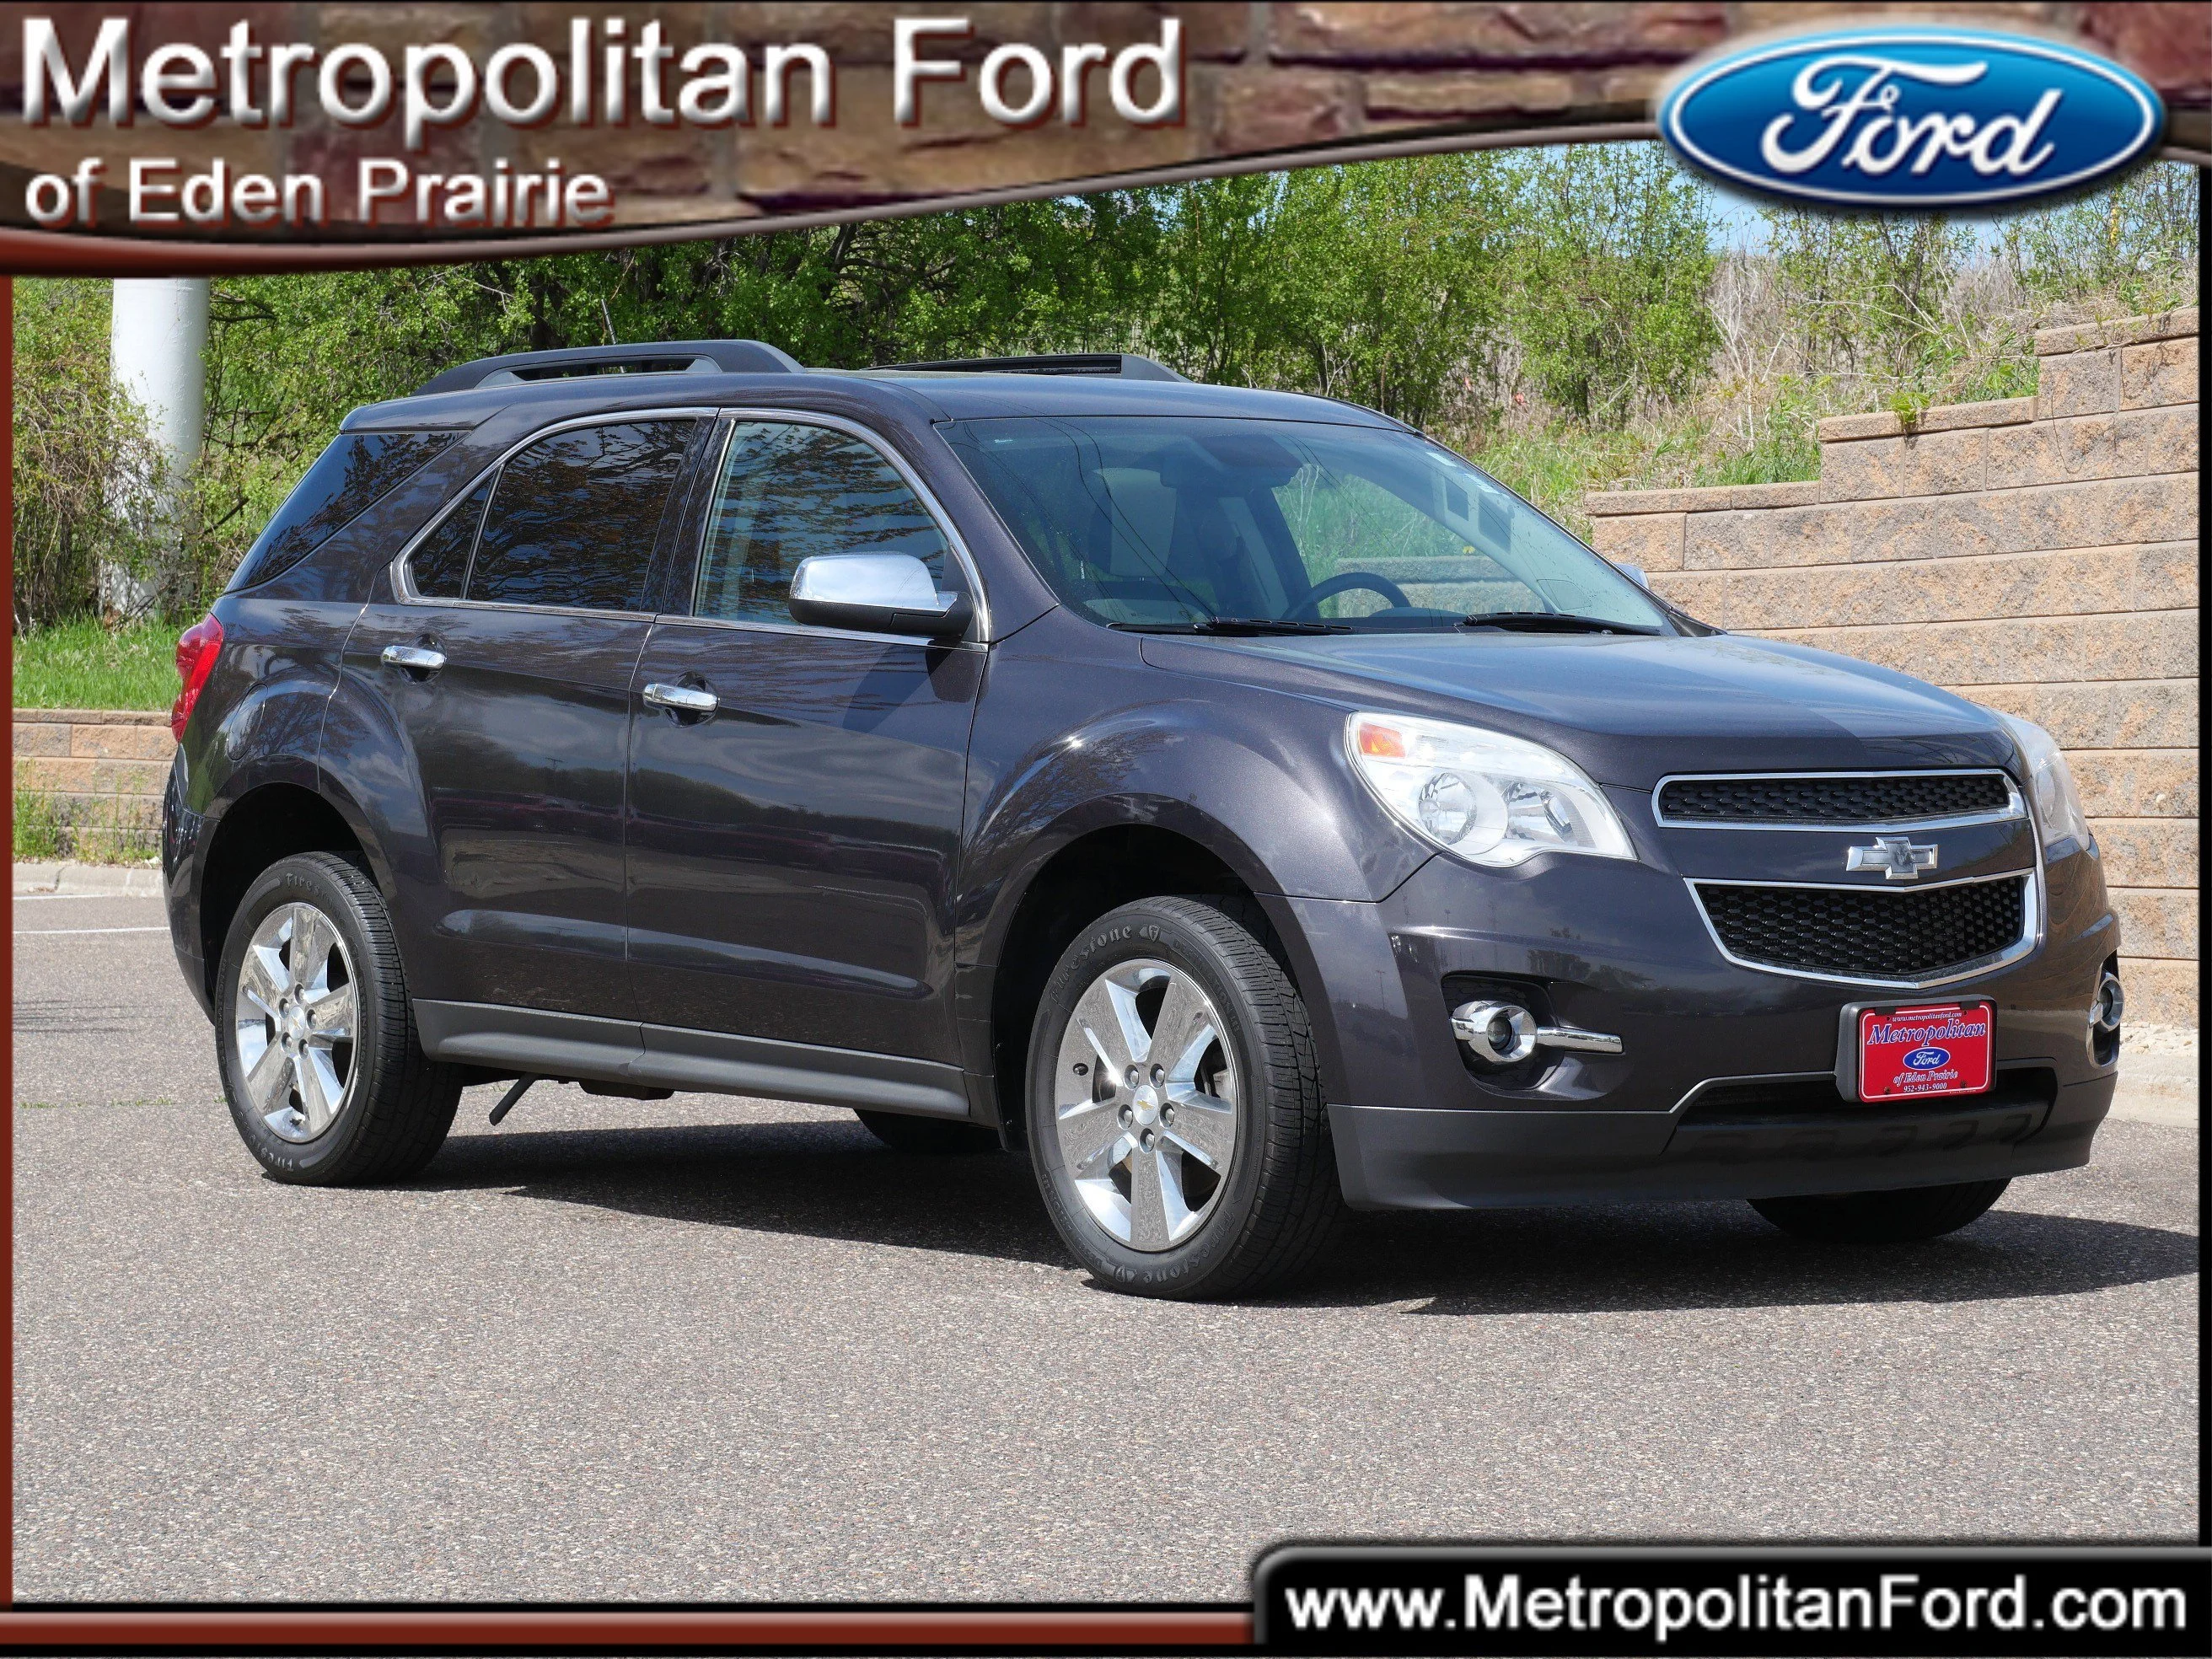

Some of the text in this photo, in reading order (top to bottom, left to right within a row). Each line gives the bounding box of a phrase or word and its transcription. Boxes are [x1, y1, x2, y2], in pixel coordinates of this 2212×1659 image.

[1892, 1012, 1962, 1023] www.metropolitanford.com
[1867, 1018, 1986, 1047] Metropolitan
[1913, 1051, 1940, 1066] Ford
[1893, 1068, 1958, 1087] of Eden Prairie
[1903, 1082, 1947, 1093] 952-943-9000
